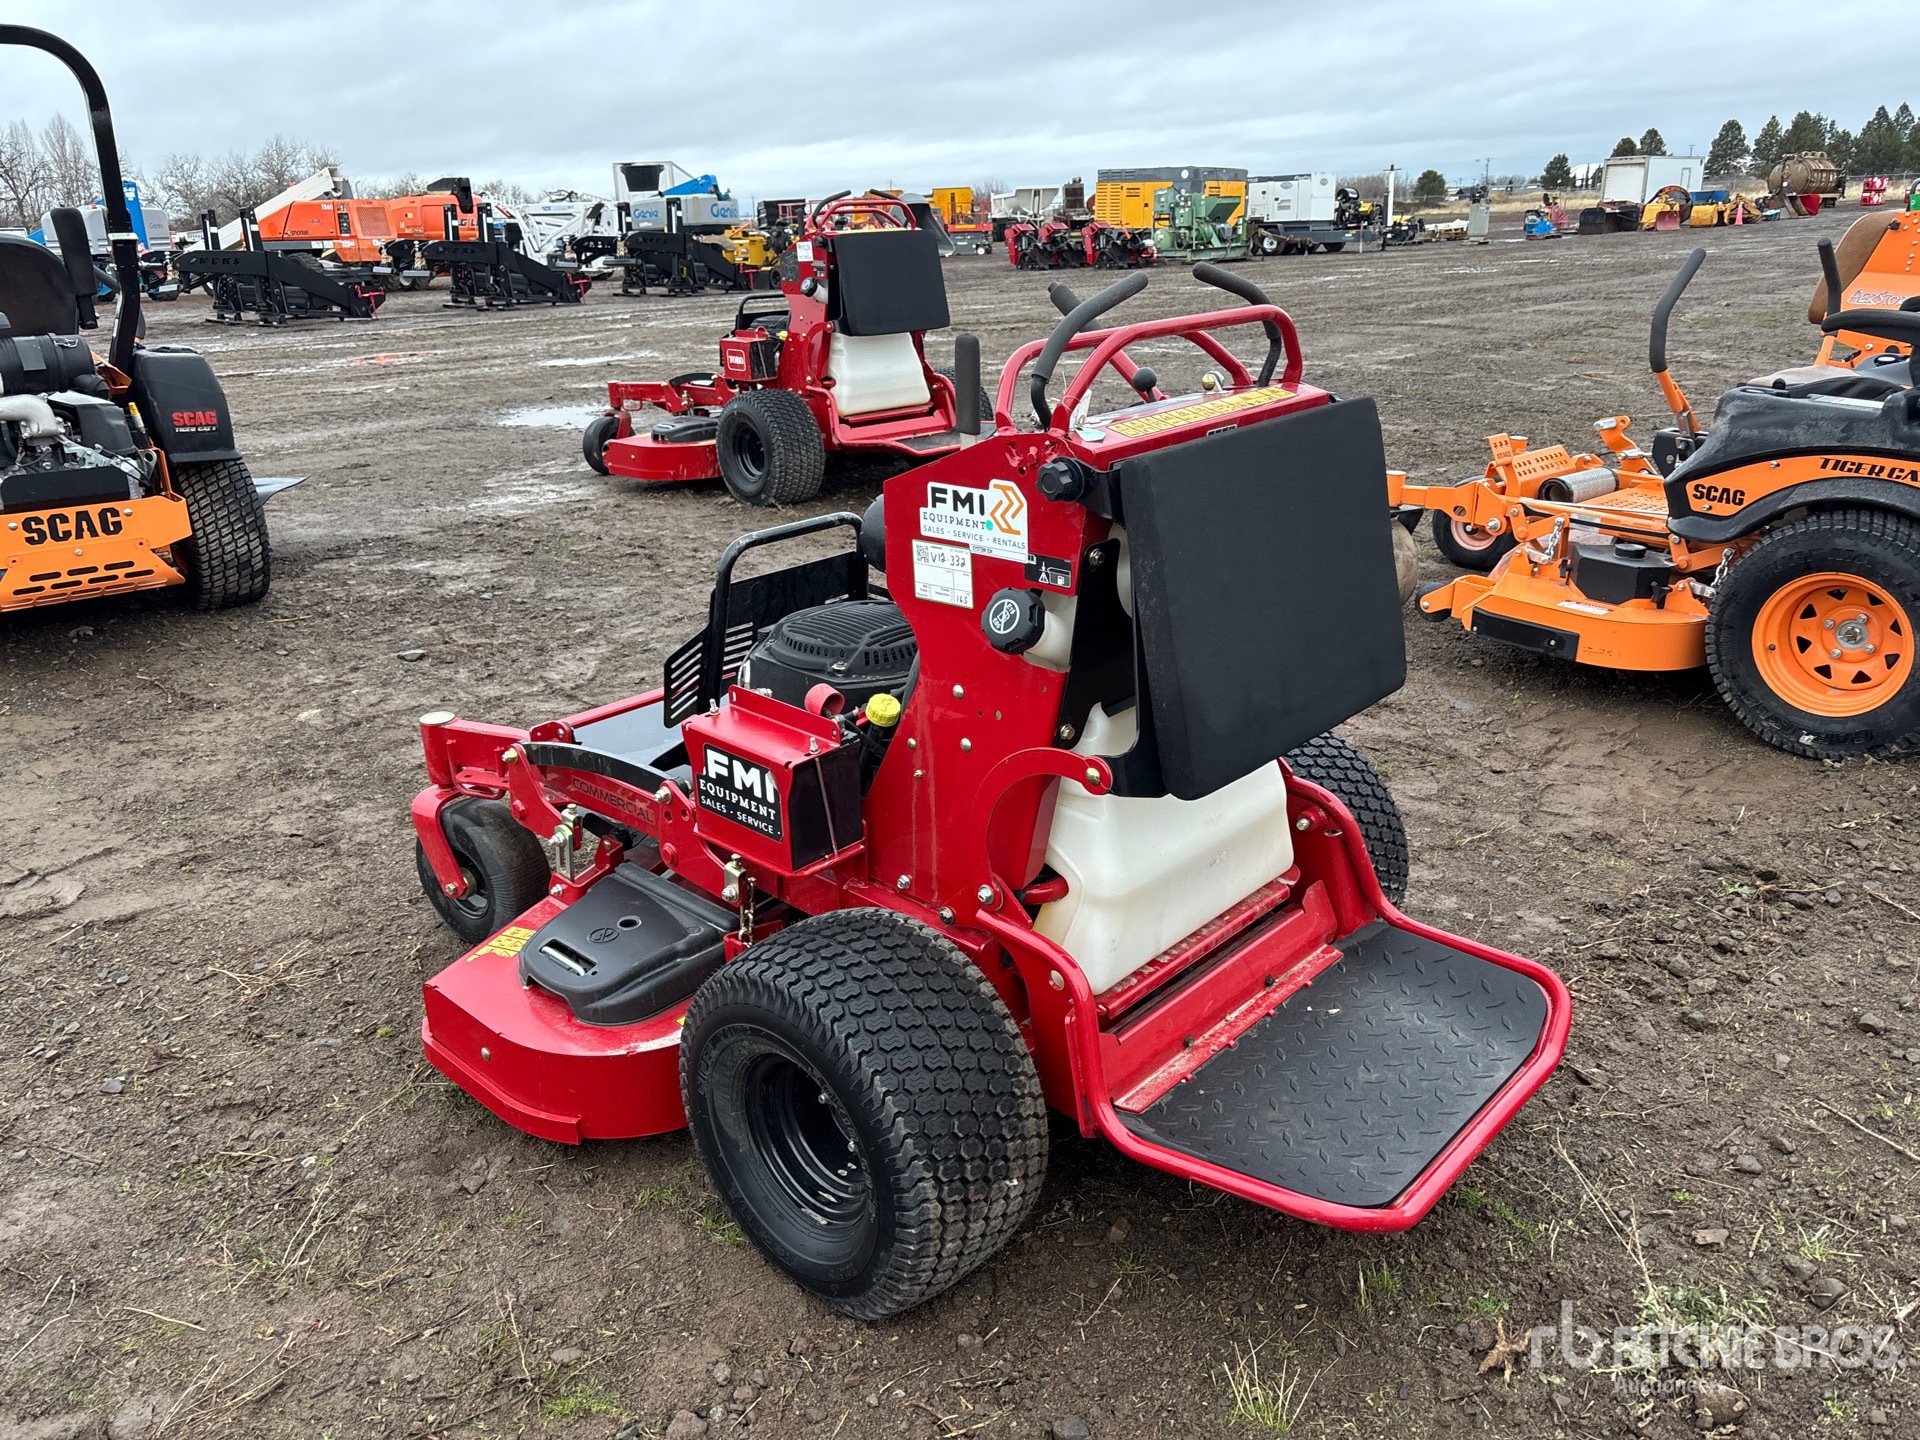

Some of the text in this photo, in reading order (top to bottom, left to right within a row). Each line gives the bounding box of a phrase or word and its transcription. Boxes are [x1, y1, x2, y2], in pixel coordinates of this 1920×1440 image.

[633, 209, 660, 218] Genie
[710, 203, 738, 218] Genie
[172, 411, 217, 426] SCAG
[1819, 458, 1920, 482] TIGER CA
[931, 486, 985, 516] FMI
[1692, 484, 1745, 506] SCAG
[21, 507, 123, 545] SCAG
[922, 511, 986, 530] EQUIPMENT
[923, 525, 945, 535] SALES
[953, 529, 983, 542] SERVICE
[992, 537, 1026, 550] RENTALS
[706, 749, 775, 804] FMI
[572, 778, 654, 823] COMMERCIAL
[699, 779, 776, 820] EQUIPMENT
[701, 796, 774, 834] SALES SERVICE
